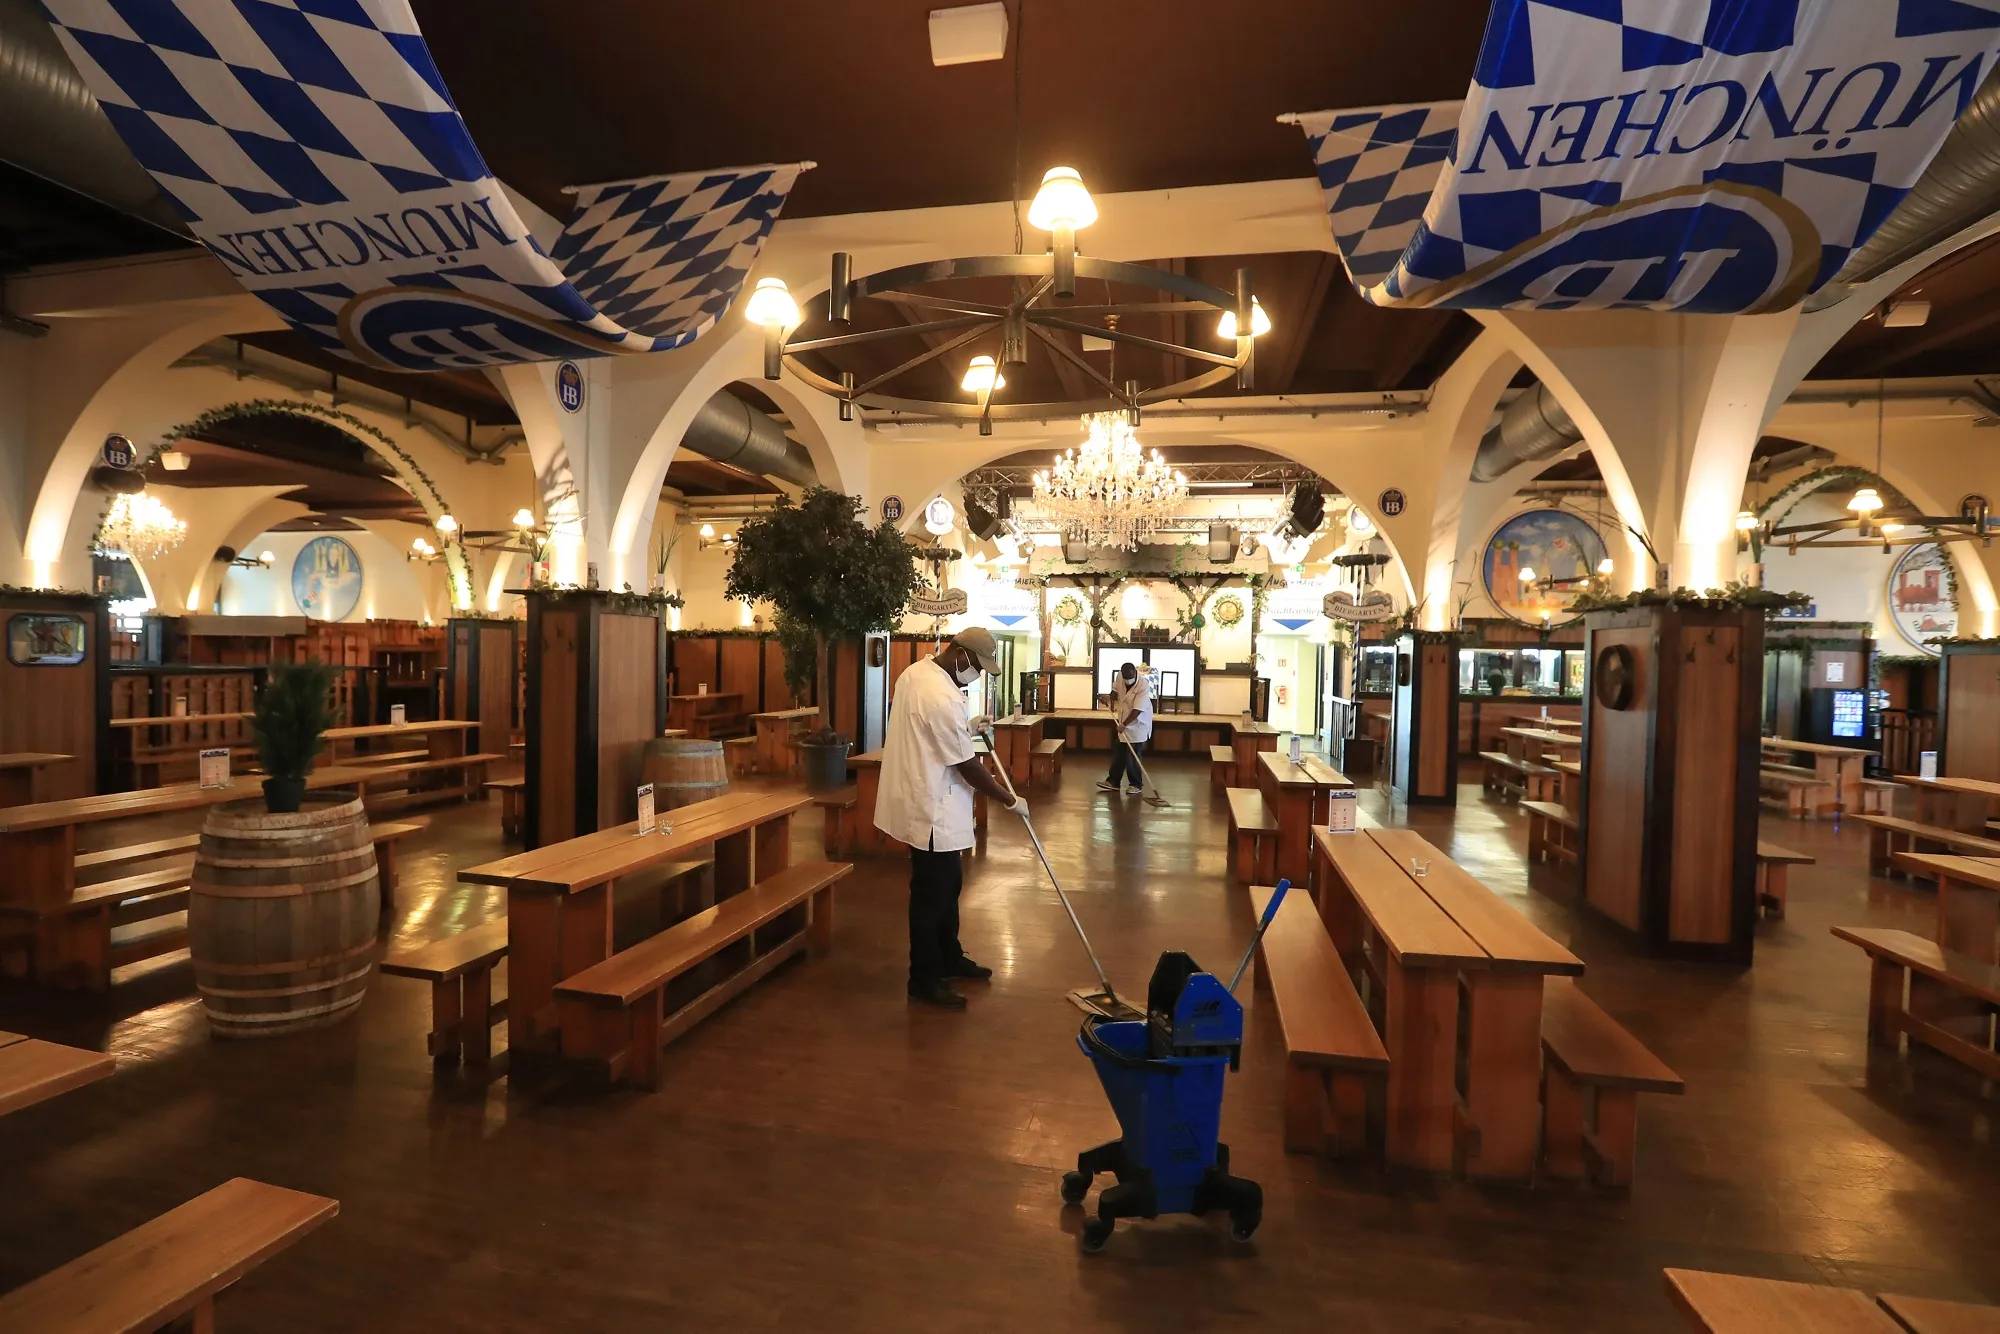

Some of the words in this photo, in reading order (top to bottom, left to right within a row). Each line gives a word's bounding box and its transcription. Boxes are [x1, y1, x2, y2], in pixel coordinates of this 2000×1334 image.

[1460, 49, 1999, 174] MÜNCHEN
[199, 196, 518, 277] MÜNCHEN
[562, 383, 578, 406] HB
[110, 450, 128, 466] HB
[1386, 501, 1400, 513] HB
[916, 601, 959, 611] BIERGARTEN
[1334, 604, 1385, 616] BIERGARTEN
